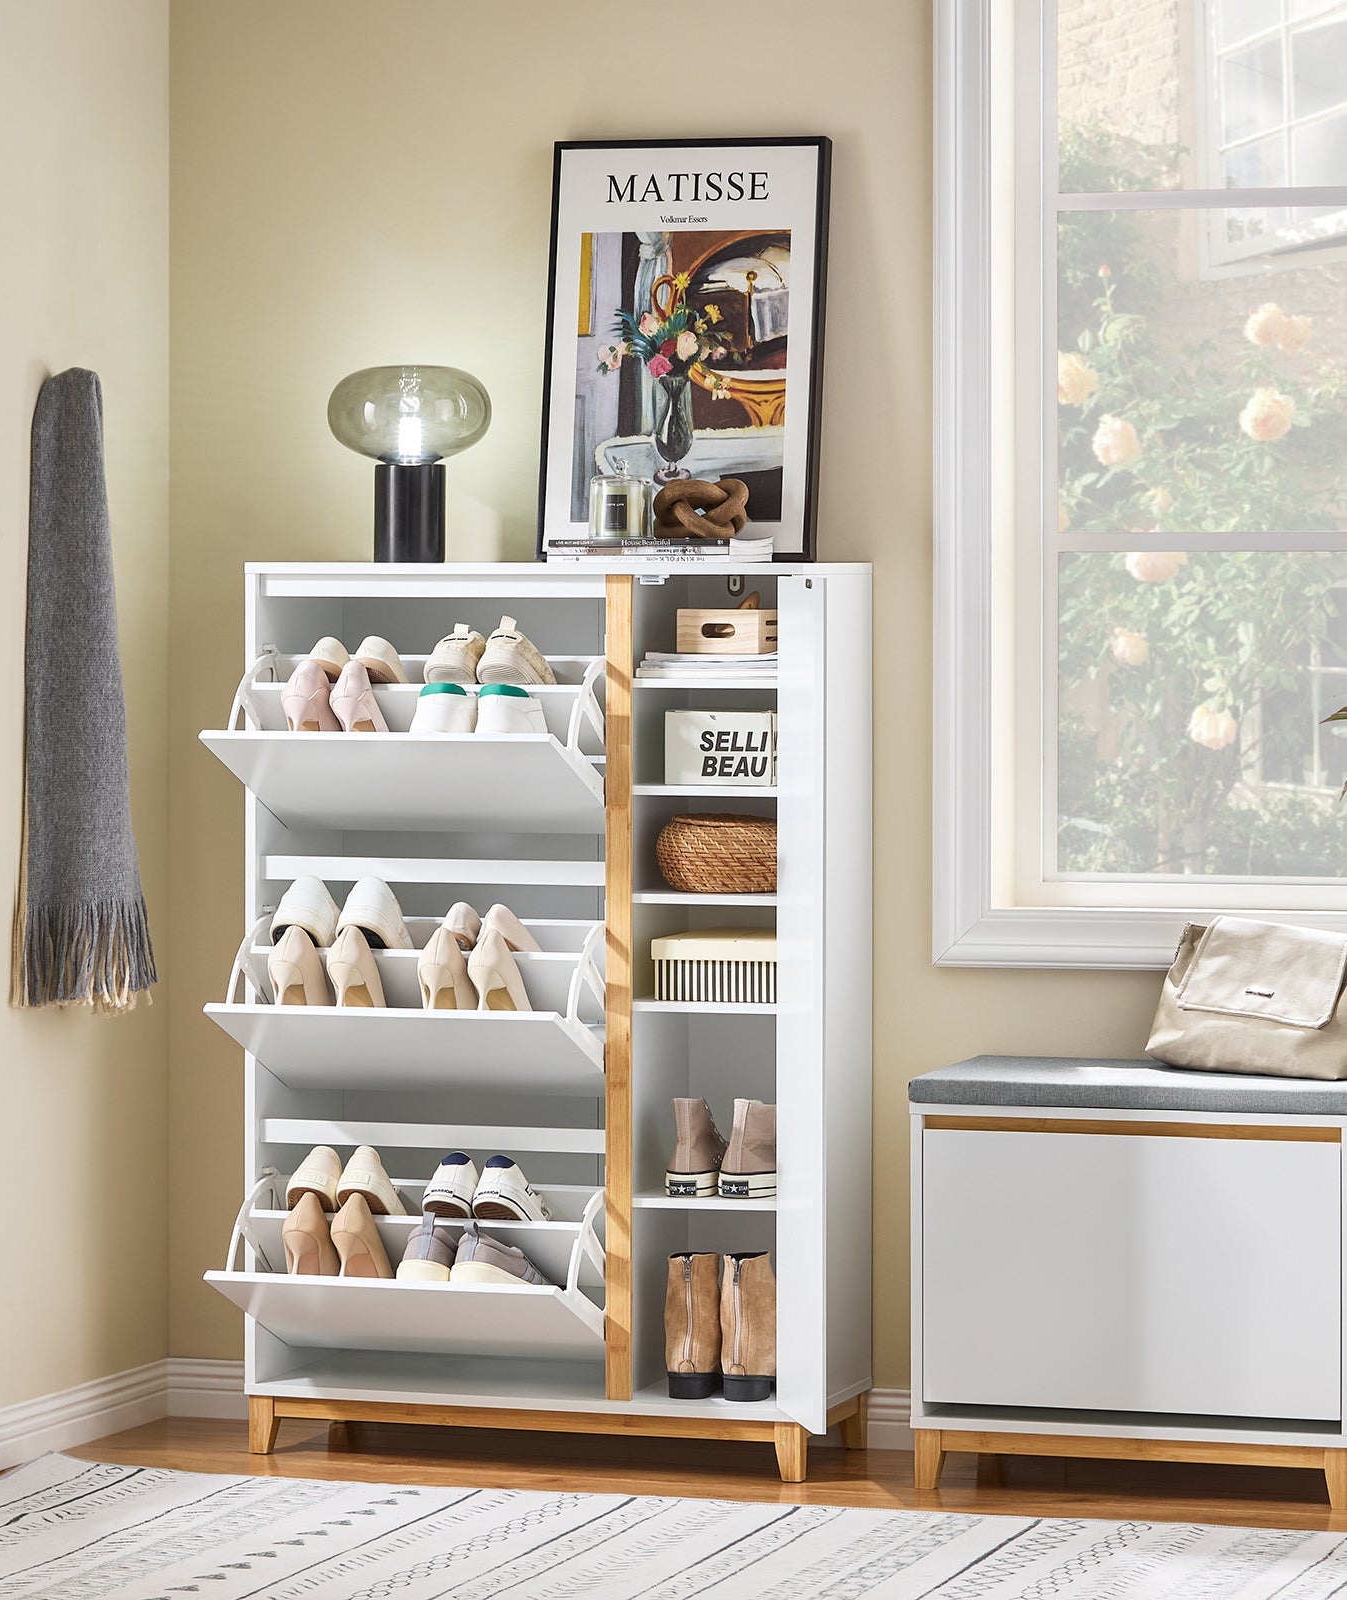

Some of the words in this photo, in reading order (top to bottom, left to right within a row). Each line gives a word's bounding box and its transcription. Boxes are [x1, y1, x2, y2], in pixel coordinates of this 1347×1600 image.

[606, 172, 769, 203] MATISSE
[660, 215, 688, 224] Volkmar
[688, 215, 708, 223] Essers
